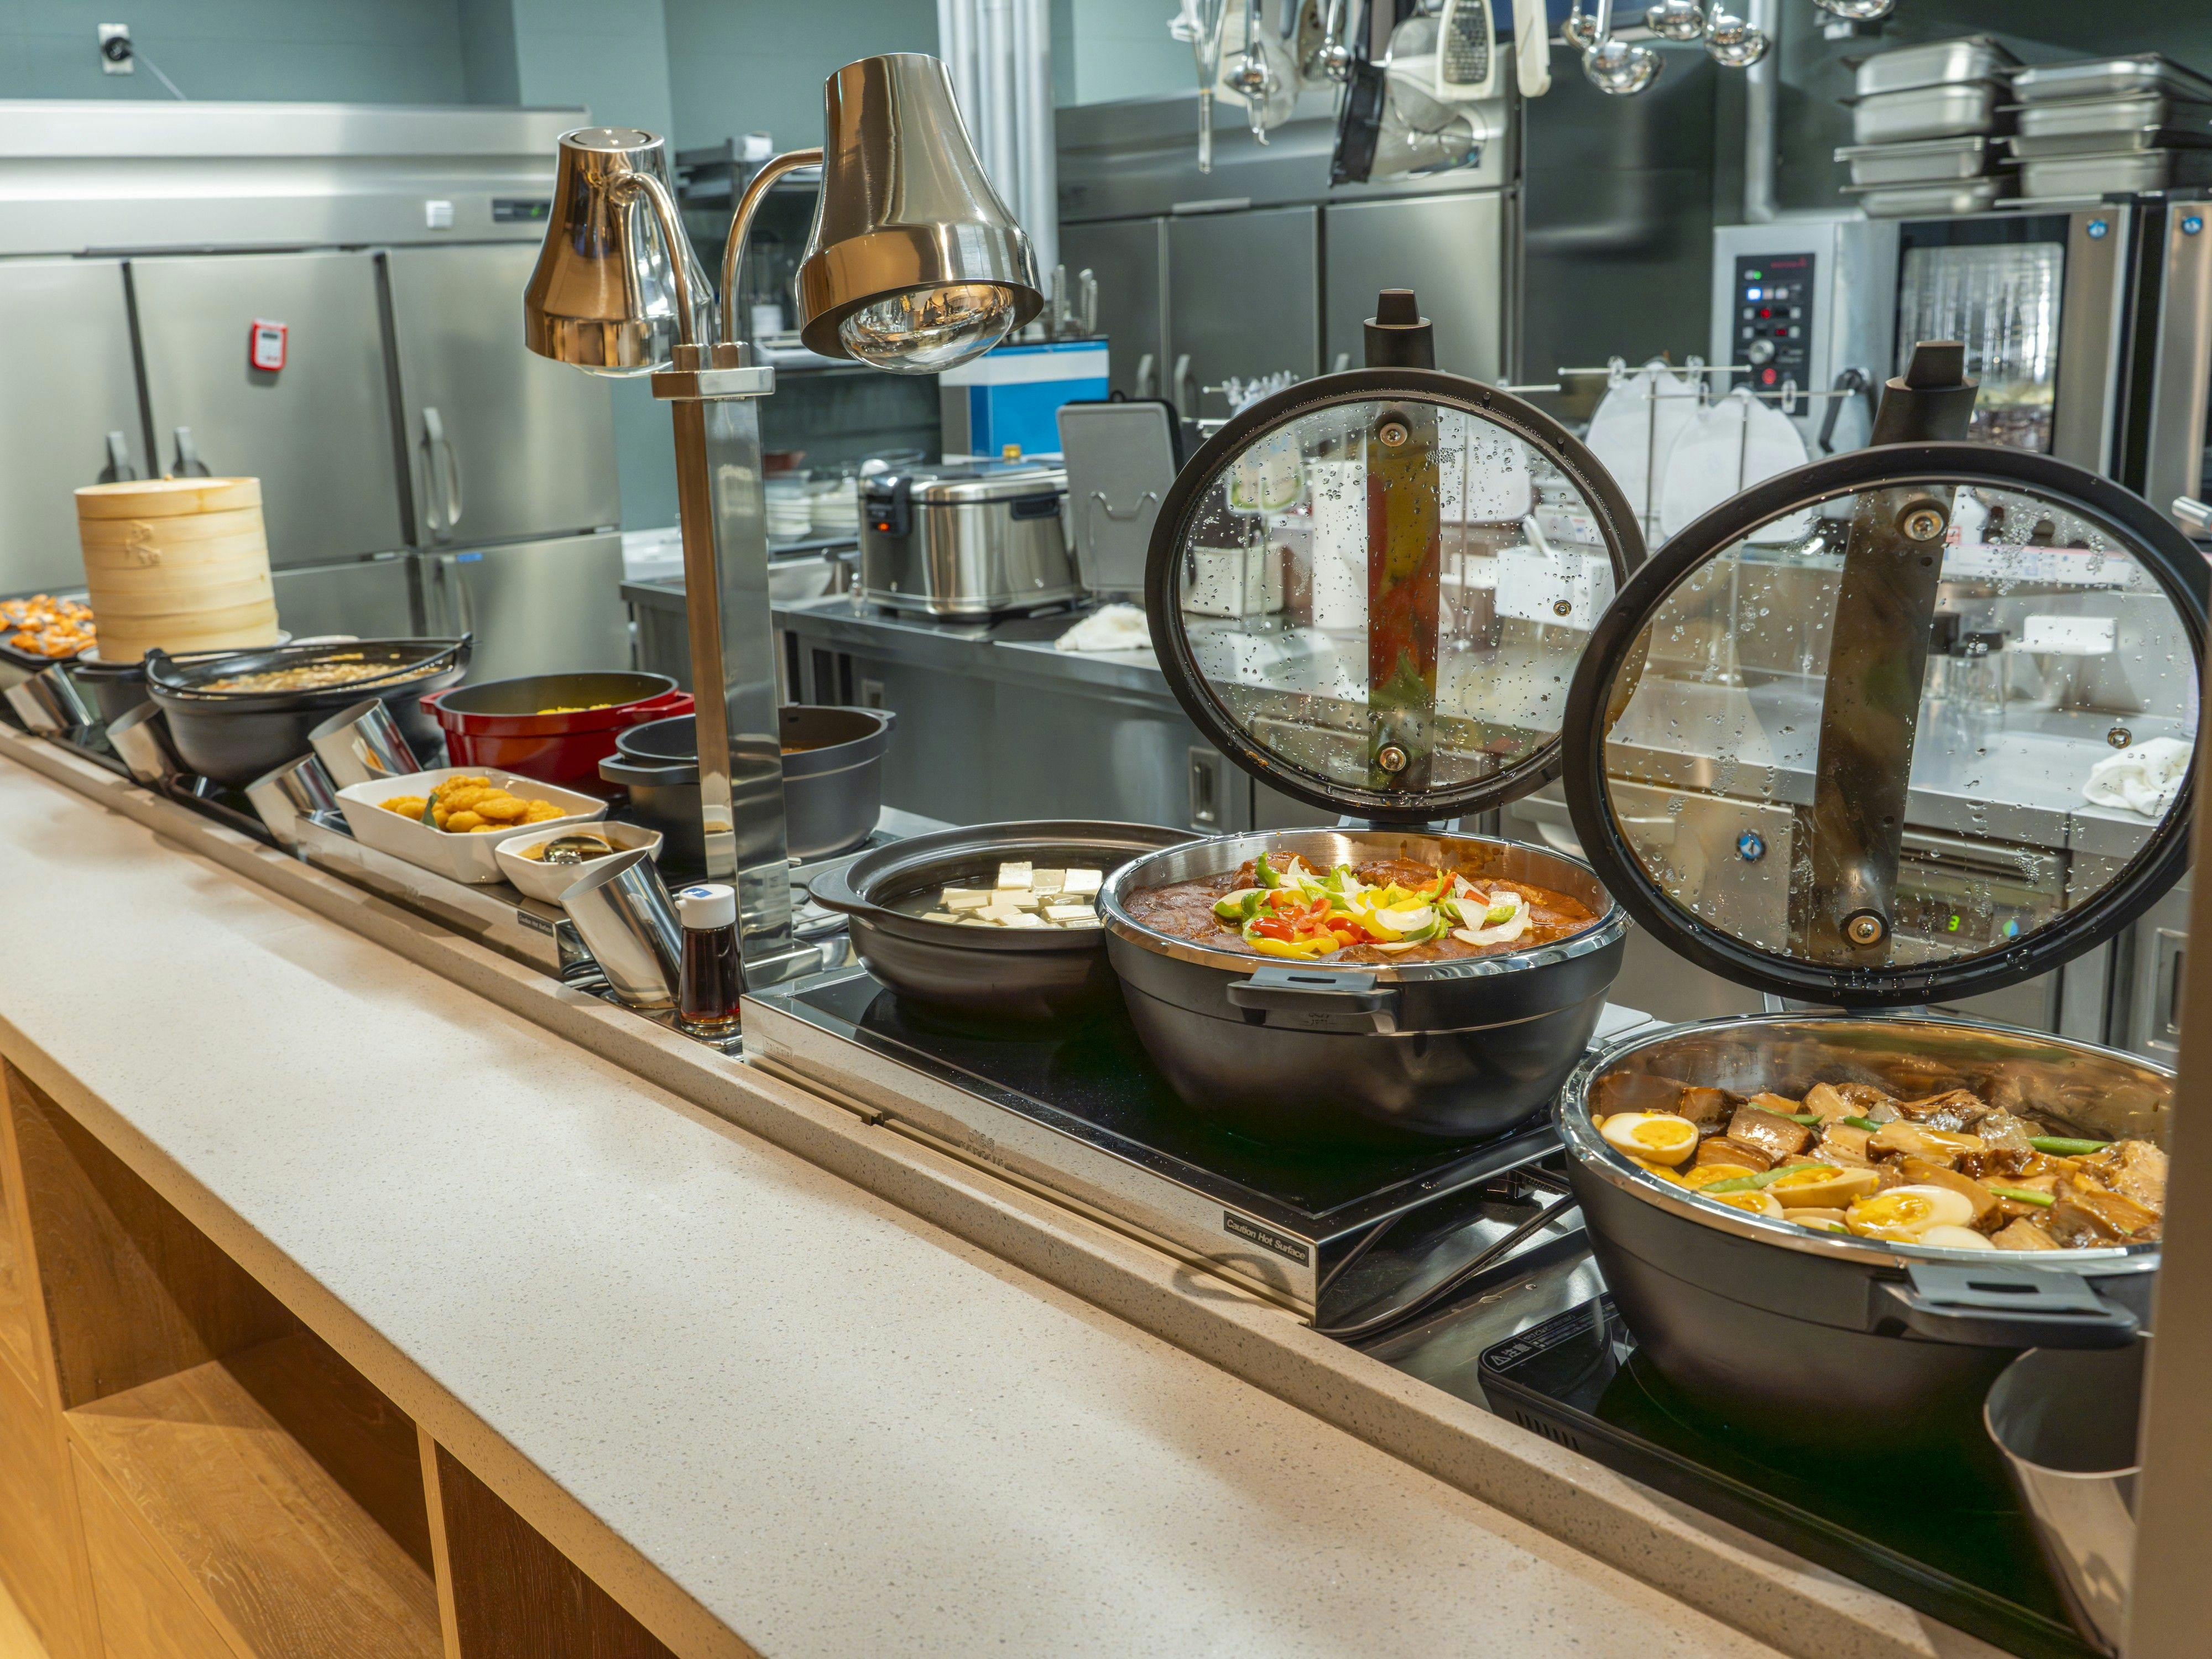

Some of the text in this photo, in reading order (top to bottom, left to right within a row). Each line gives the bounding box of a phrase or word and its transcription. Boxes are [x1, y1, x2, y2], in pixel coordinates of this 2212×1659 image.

[1948, 915, 1960, 931] 3
[1227, 1219, 1306, 1260] Caution Hot Surface
